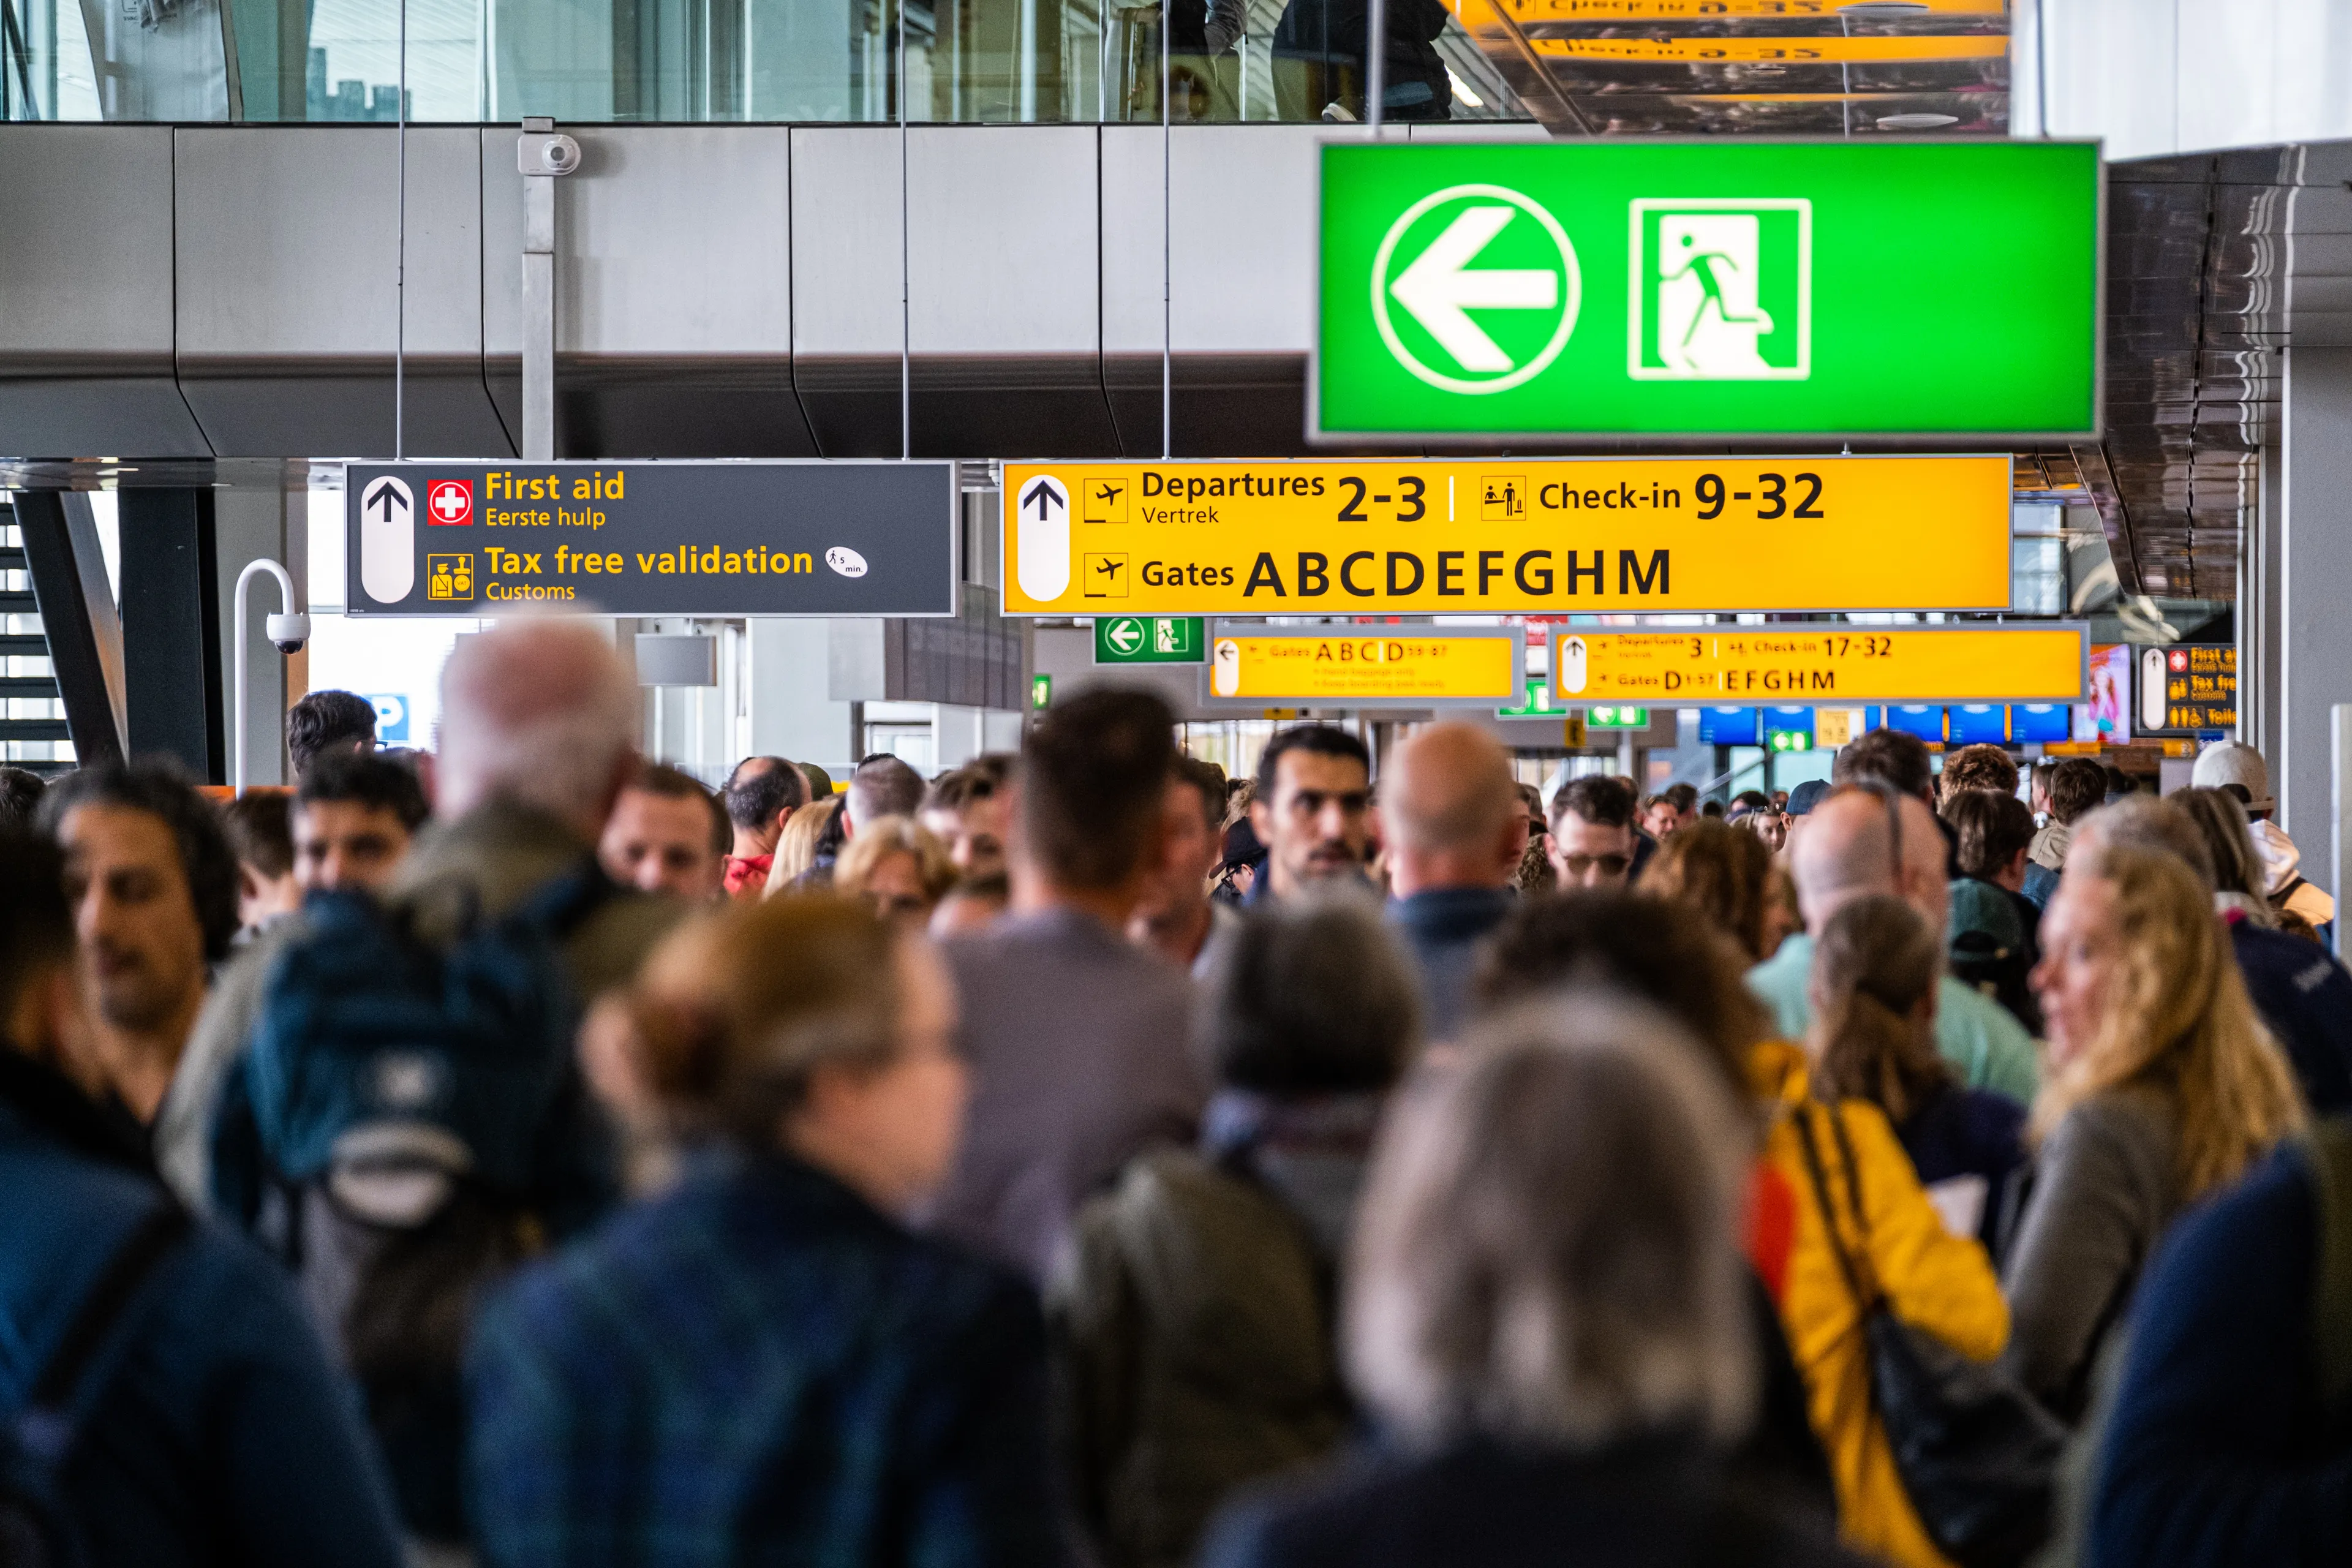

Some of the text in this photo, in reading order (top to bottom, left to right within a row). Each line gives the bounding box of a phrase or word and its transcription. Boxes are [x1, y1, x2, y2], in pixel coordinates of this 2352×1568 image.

[486, 471, 624, 499] First aid
[1540, 473, 1824, 520] Check-in 9-32
[1142, 472, 1425, 522] Departures 2-3
[486, 507, 605, 530] Eerste hulp
[1142, 507, 1219, 523] Vertrek
[484, 545, 812, 574] Tax free validation
[1142, 561, 1234, 586] Gates
[486, 582, 575, 600] Customs
[1690, 638, 1702, 658] 3
[1755, 637, 1891, 657] Check-in 17-32
[1618, 674, 1659, 685] Gates
[2190, 674, 2236, 691] Tax fre
[371, 696, 404, 741] P
